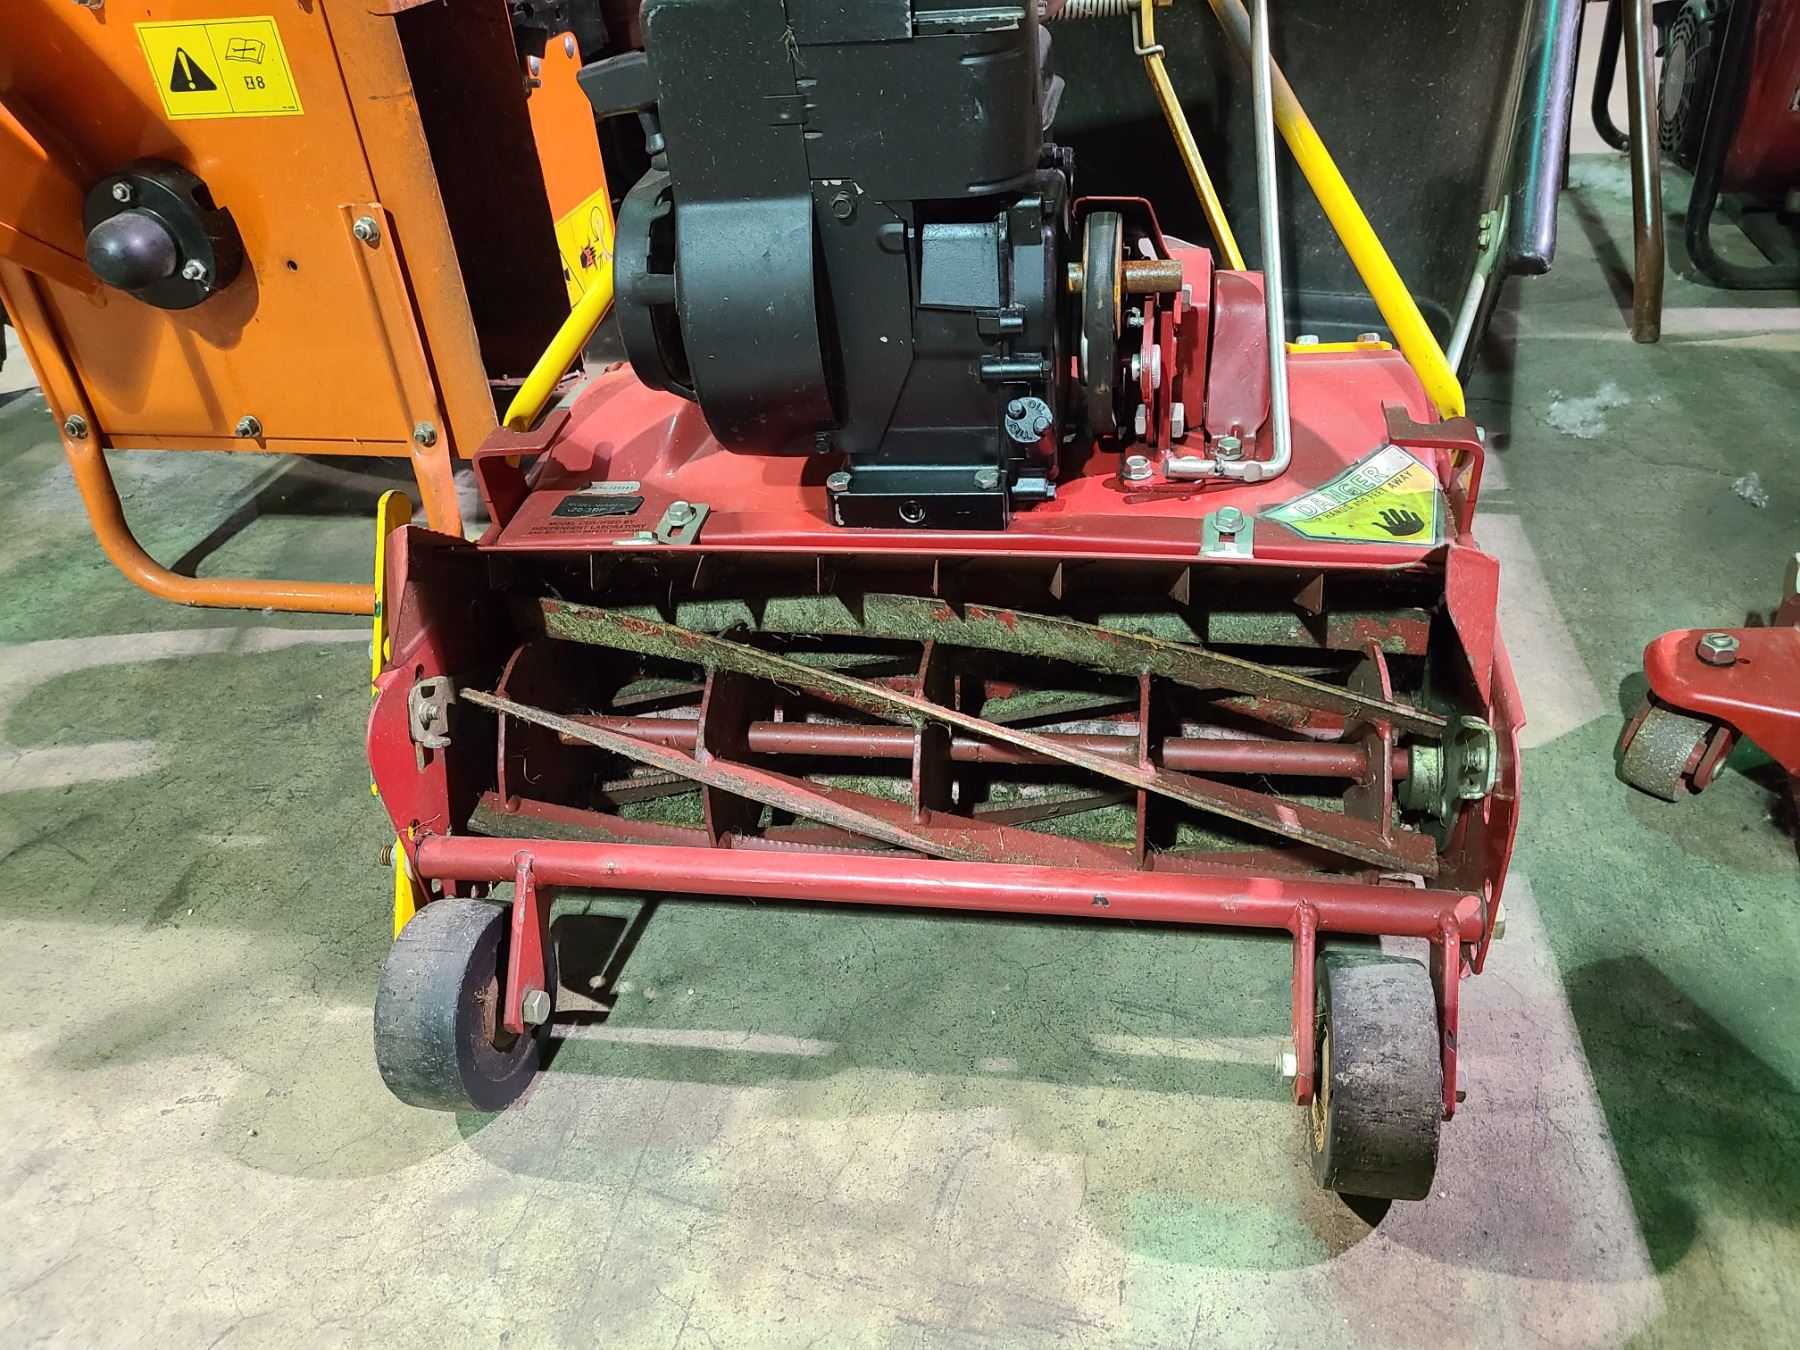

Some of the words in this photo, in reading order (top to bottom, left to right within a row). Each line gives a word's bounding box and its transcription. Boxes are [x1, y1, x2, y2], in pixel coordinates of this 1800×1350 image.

[1027, 399, 1046, 416] OIL
[1387, 470, 1413, 490] AWAY
[1293, 465, 1389, 517] DANGER
